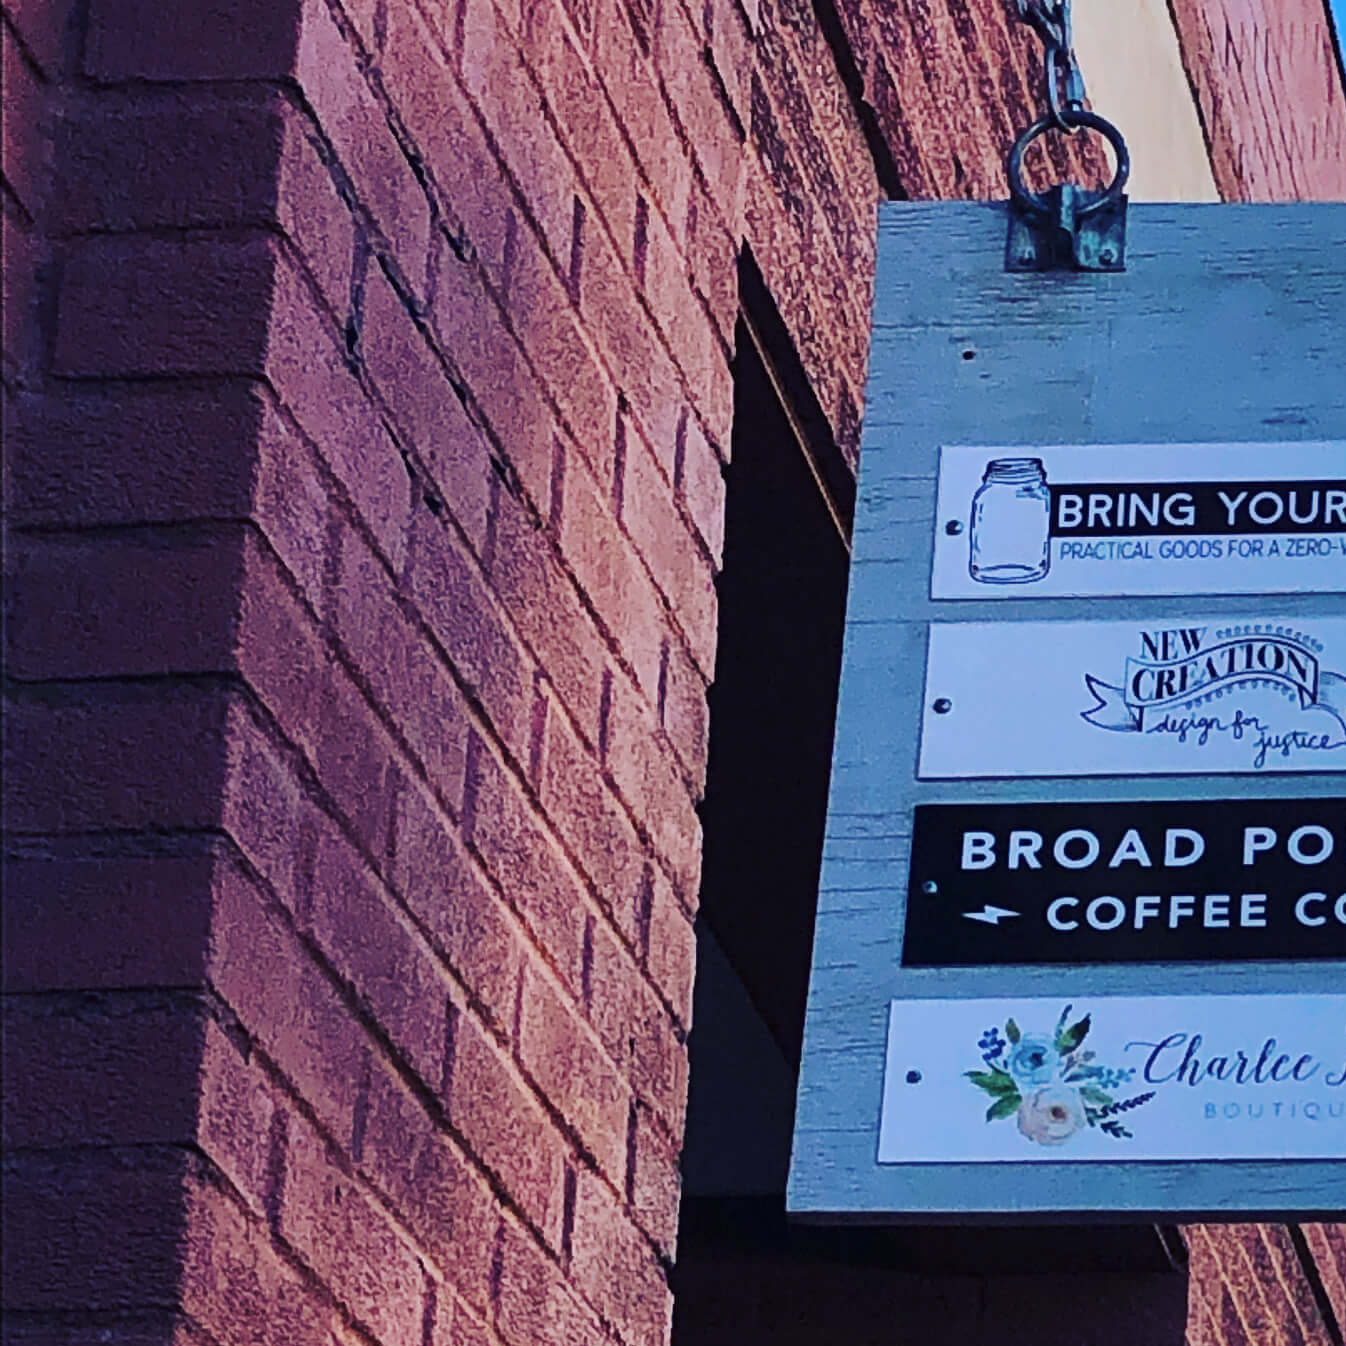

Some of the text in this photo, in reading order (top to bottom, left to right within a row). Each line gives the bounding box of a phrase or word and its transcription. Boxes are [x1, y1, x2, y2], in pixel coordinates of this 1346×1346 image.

[1058, 492, 1195, 528] BRING
[1060, 539, 1155, 560] PRACTICAL
[1159, 538, 1223, 559] GOODS
[1228, 538, 1263, 558] FOR
[1267, 538, 1280, 557] A
[1140, 627, 1207, 662] NEW
[1131, 643, 1309, 702] CREATION
[1146, 709, 1269, 746] design for
[960, 827, 1206, 871] BROAD
[1046, 893, 1269, 931] COFFEE
[1124, 1032, 1321, 1087] Charlee
